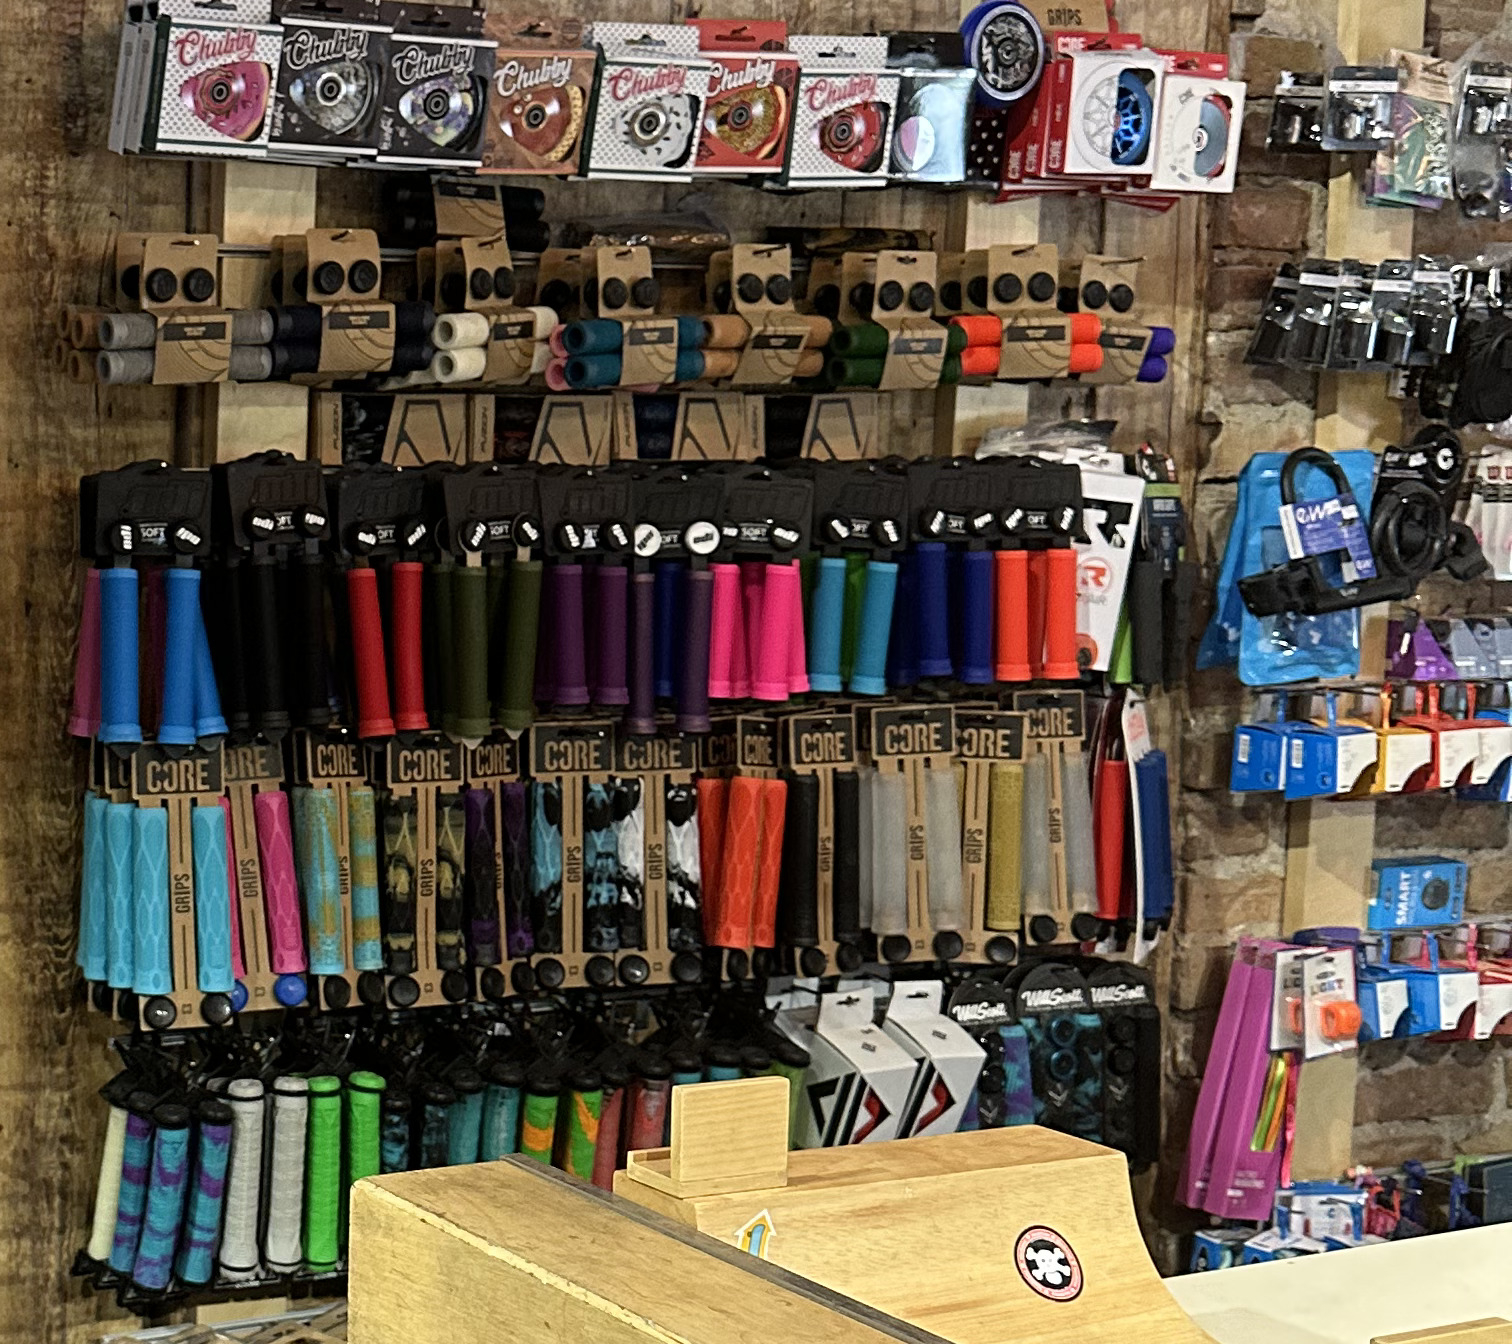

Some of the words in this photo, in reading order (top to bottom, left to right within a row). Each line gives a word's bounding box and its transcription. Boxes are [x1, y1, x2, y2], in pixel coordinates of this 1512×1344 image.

[1046, 7, 1083, 28] GRIPS
[174, 25, 258, 67] Chubby
[284, 26, 369, 70] Chubby
[391, 44, 476, 86] Chubby
[493, 56, 573, 97] Chubby
[608, 62, 689, 101] Chubby
[804, 72, 879, 112] Chubby
[544, 739, 603, 771] CORE
[623, 738, 683, 770] CORE
[744, 735, 774, 765] CORE
[800, 731, 846, 763] CORE
[884, 722, 943, 754] CORE
[146, 758, 210, 794] CORE
[225, 746, 270, 778] ORE
[317, 743, 359, 776] CORE
[399, 748, 452, 781] CORE
[475, 743, 512, 775] CORE
[909, 824, 924, 861] GRIPS
[1048, 807, 1061, 844] GRIPS
[648, 843, 663, 880] GRIPS
[820, 835, 831, 872] GRIPS
[965, 827, 984, 864] GRIPS
[240, 857, 259, 898] GRIPS
[420, 858, 434, 897] GRIPS
[566, 846, 581, 883] GRIPS
[173, 873, 191, 914] GRIPS
[1394, 871, 1412, 926] SMART
